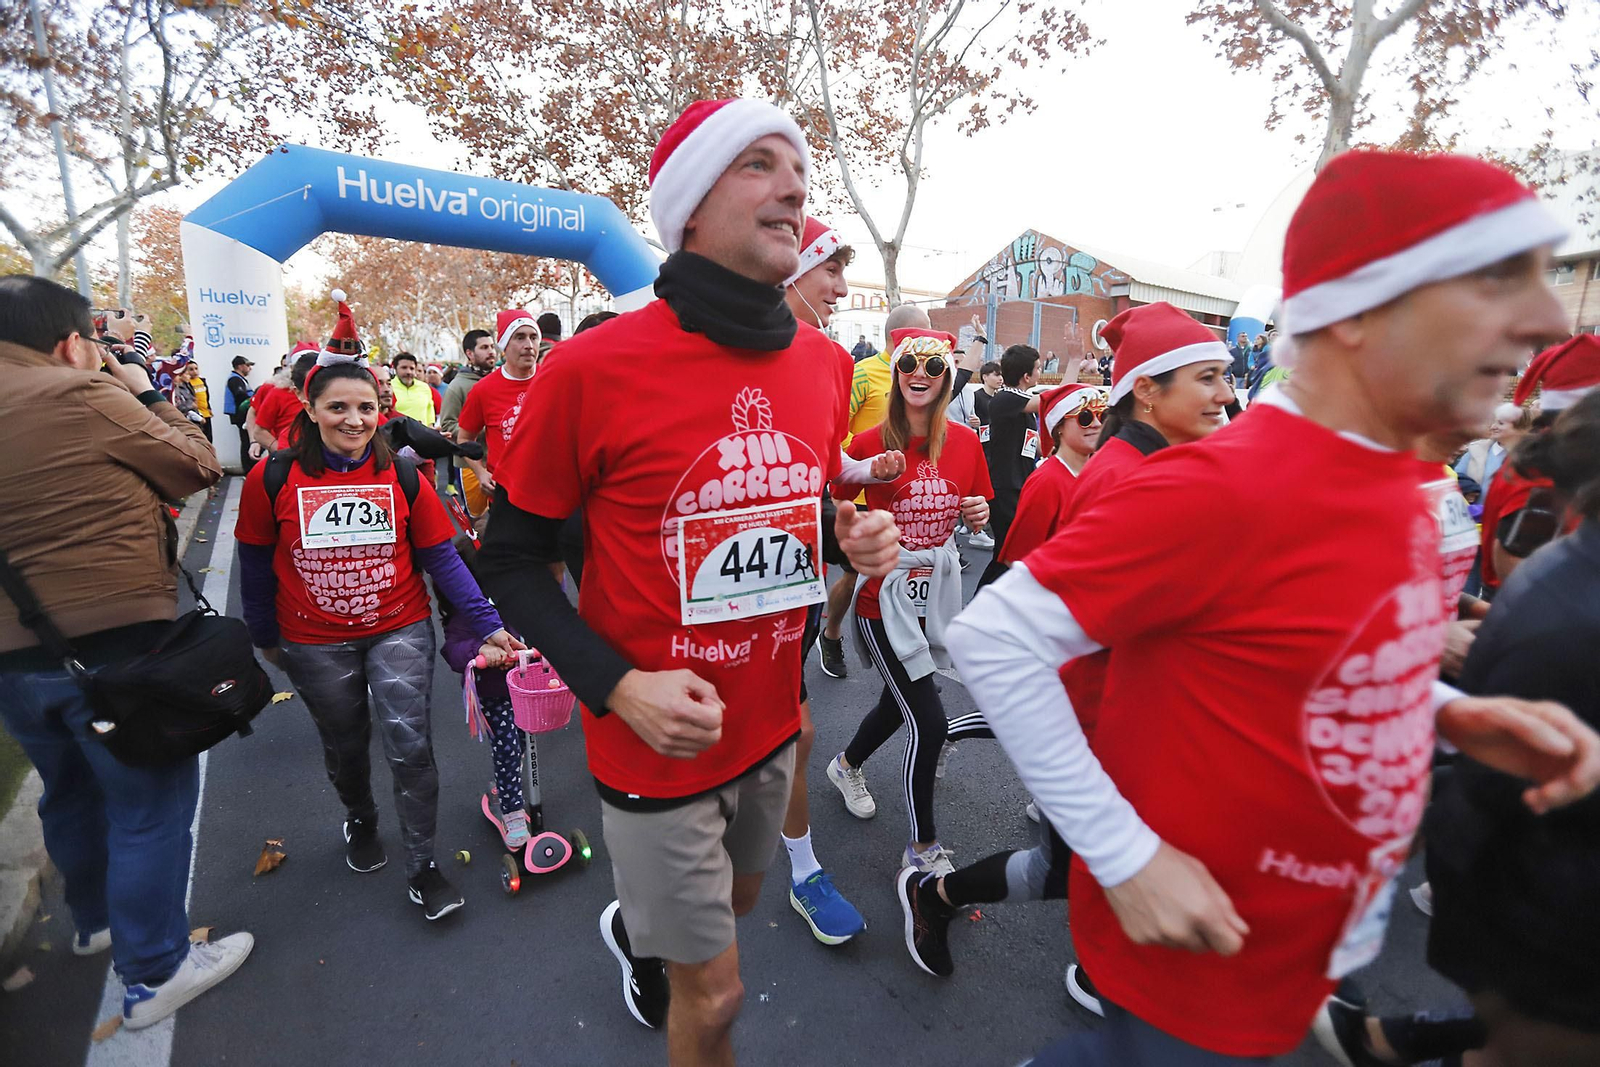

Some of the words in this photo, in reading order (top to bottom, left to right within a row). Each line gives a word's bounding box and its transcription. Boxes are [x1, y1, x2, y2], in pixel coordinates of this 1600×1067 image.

[337, 166, 468, 216] Huelva
[480, 193, 585, 232] original
[199, 288, 267, 306] Huelva
[229, 337, 270, 346] HUELVA
[717, 433, 792, 471] XIII
[676, 463, 821, 514] CARRERA
[909, 479, 948, 495] XIII
[326, 502, 372, 526] 473
[720, 534, 789, 582] 447
[313, 562, 395, 588] HUELVA
[338, 579, 392, 597] DICIEMBRE
[316, 593, 381, 615] 2023
[671, 635, 751, 662] Huelva
